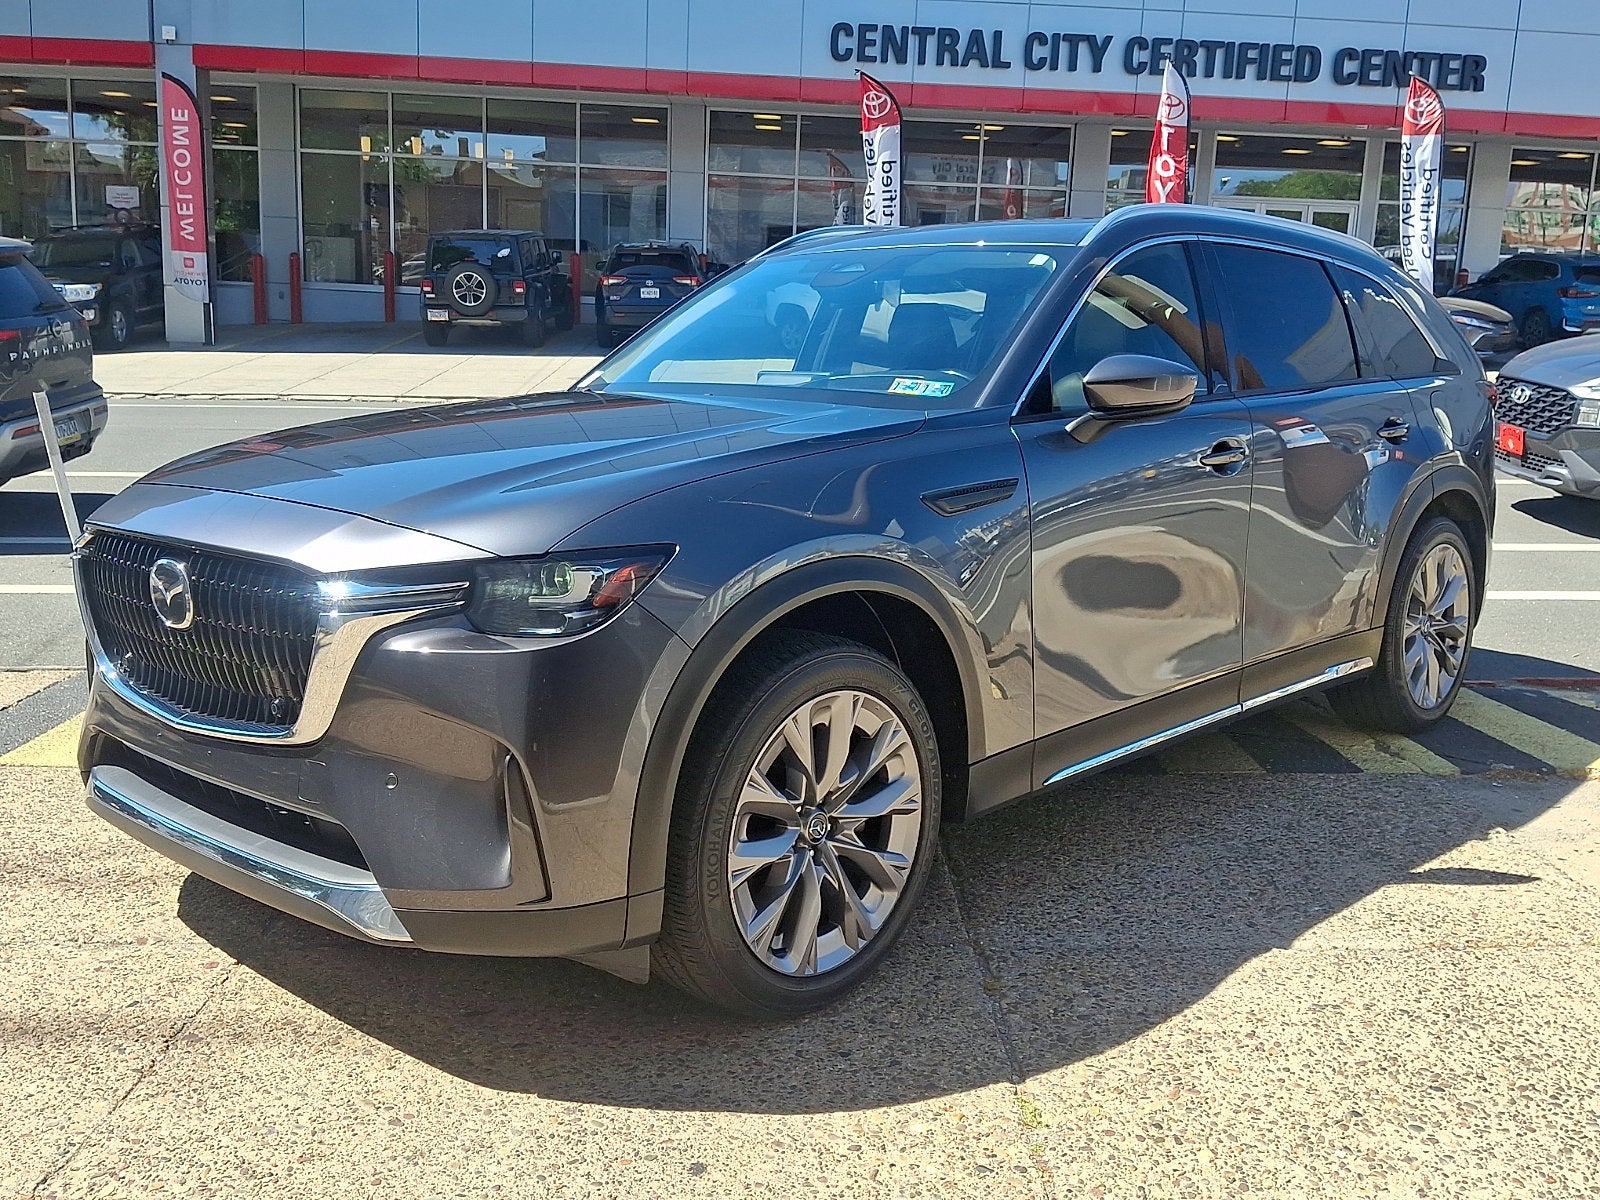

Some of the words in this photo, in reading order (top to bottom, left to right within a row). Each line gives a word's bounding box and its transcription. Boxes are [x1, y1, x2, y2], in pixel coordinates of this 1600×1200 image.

[830, 22, 1011, 69] CENTRAL
[1024, 31, 1113, 73] CITY
[1123, 36, 1321, 83] CERTIFIED
[1332, 47, 1488, 92] CENTER
[706, 797, 730, 904] YOKOHAMA
